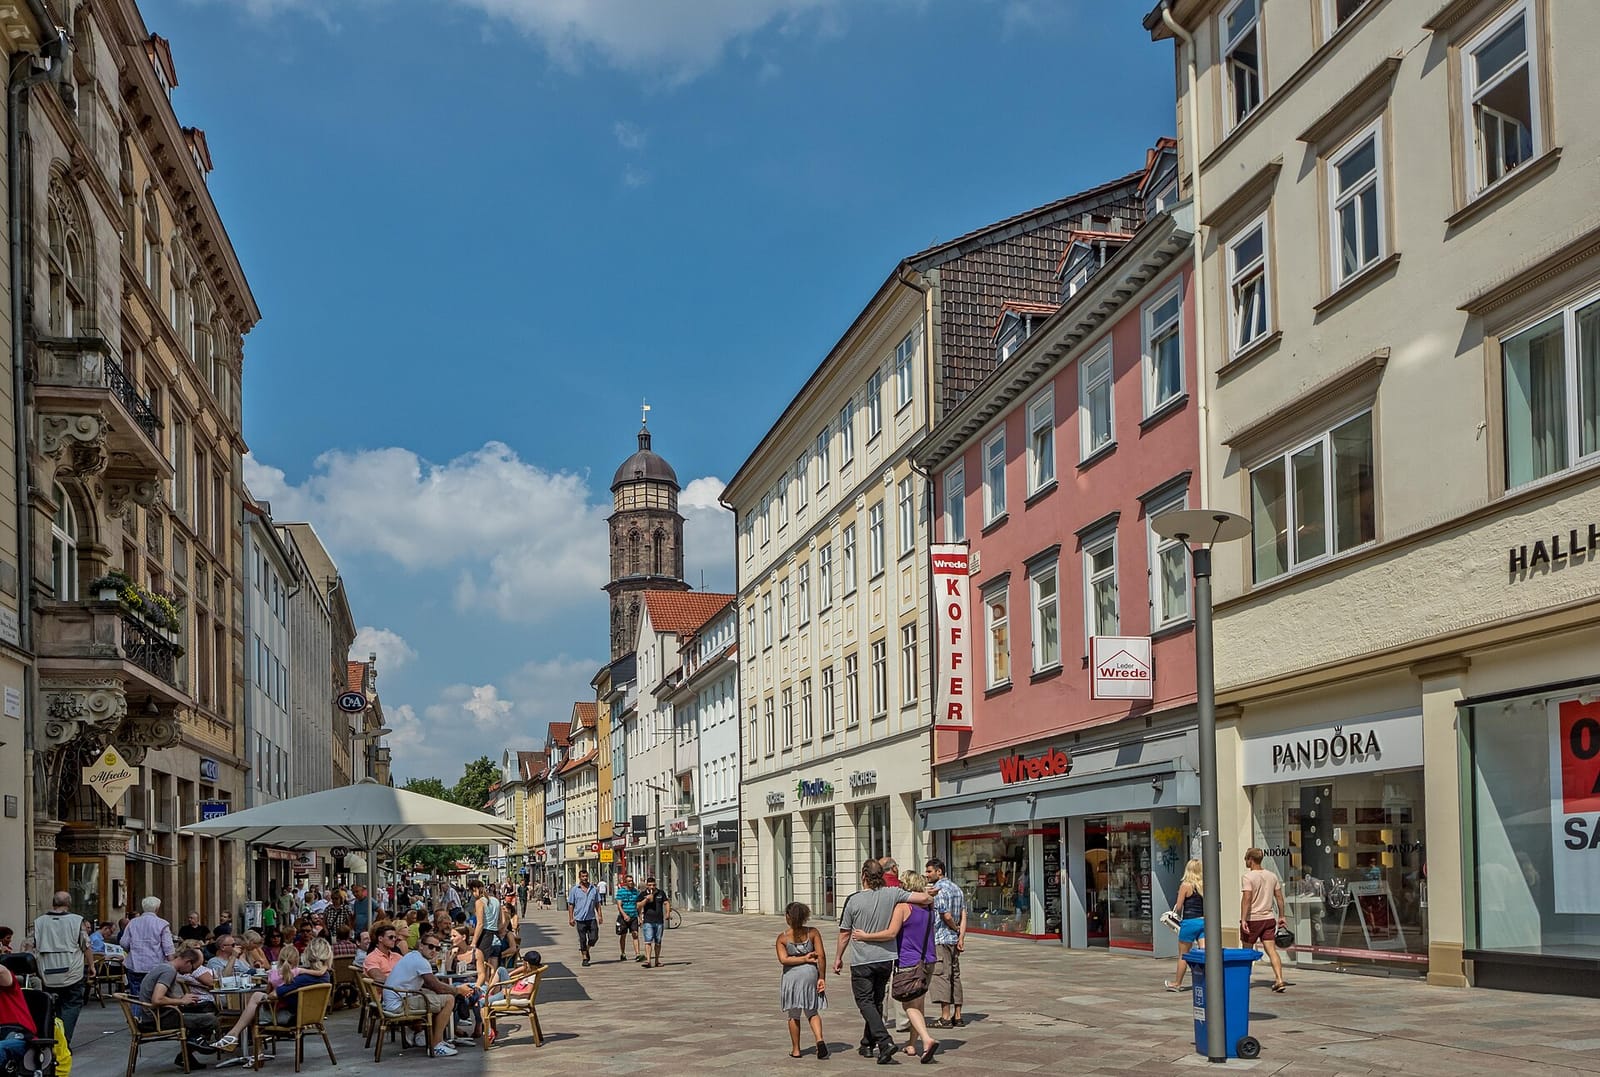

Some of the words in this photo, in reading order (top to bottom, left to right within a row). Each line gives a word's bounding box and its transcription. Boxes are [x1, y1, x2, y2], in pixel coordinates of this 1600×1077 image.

[934, 559, 967, 569] Wrede
[946, 579, 963, 720] KOFFER
[1100, 668, 1147, 678] Wrede
[342, 697, 362, 707] C&A
[1272, 729, 1381, 767] PANDORA
[999, 746, 1068, 784] Wrede
[90, 769, 131, 783] Alfredo
